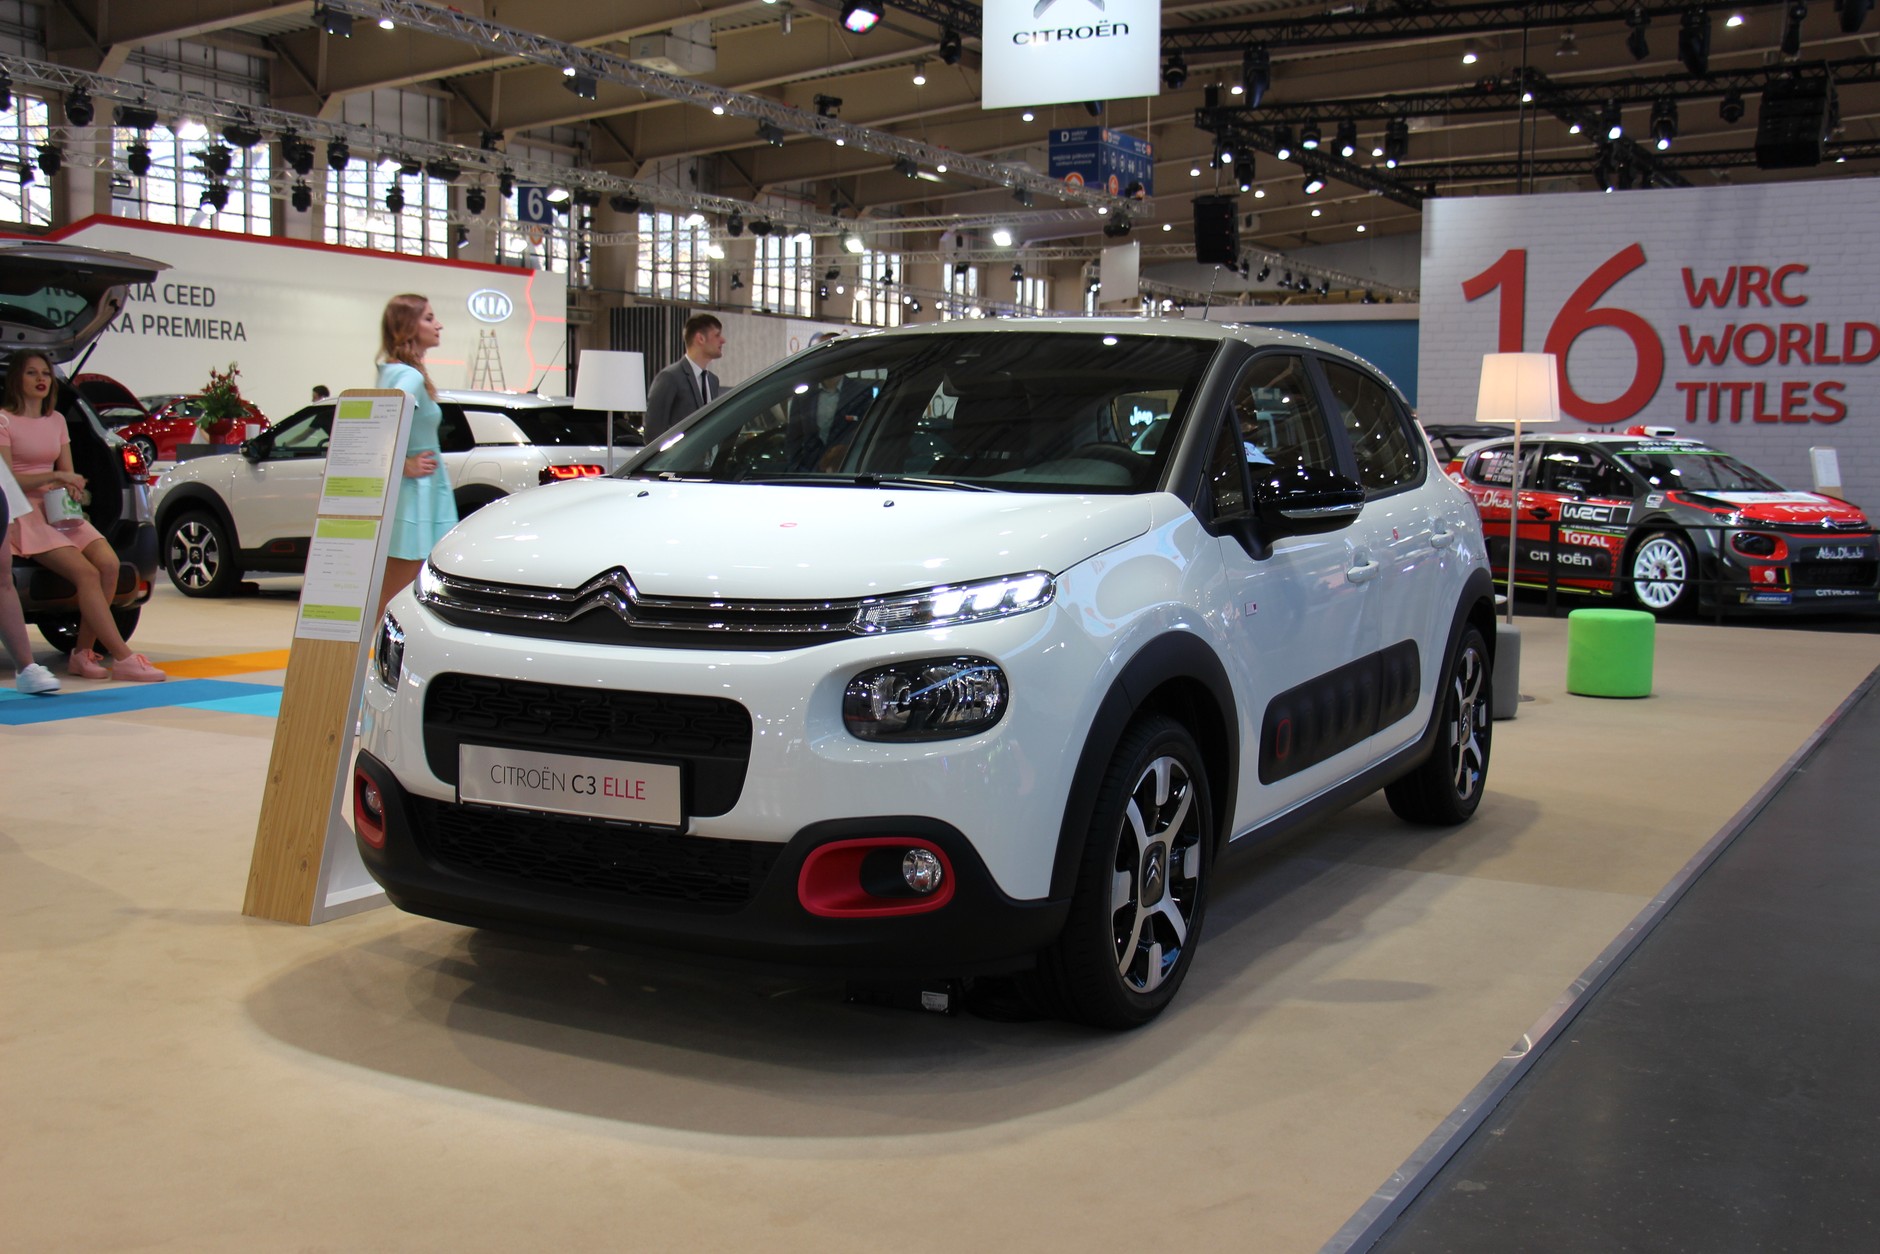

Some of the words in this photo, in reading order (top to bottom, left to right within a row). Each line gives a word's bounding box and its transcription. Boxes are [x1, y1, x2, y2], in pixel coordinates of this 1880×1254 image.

[1012, 20, 1129, 45] CITROËN
[1061, 131, 1070, 142] D
[527, 187, 544, 221] 6
[163, 283, 216, 307] CEED
[1681, 264, 1808, 308] WRC
[474, 295, 508, 318] KIA
[142, 314, 247, 342] PREMIERA
[1461, 242, 1665, 424] 16
[1679, 322, 1880, 366] WORLD
[1676, 381, 1847, 424] TITLES
[1563, 503, 1610, 522] WRC
[1562, 530, 1610, 548] TOTAL
[490, 765, 566, 792] CITROËN
[571, 774, 597, 795] C3
[603, 776, 646, 801] ELLE
